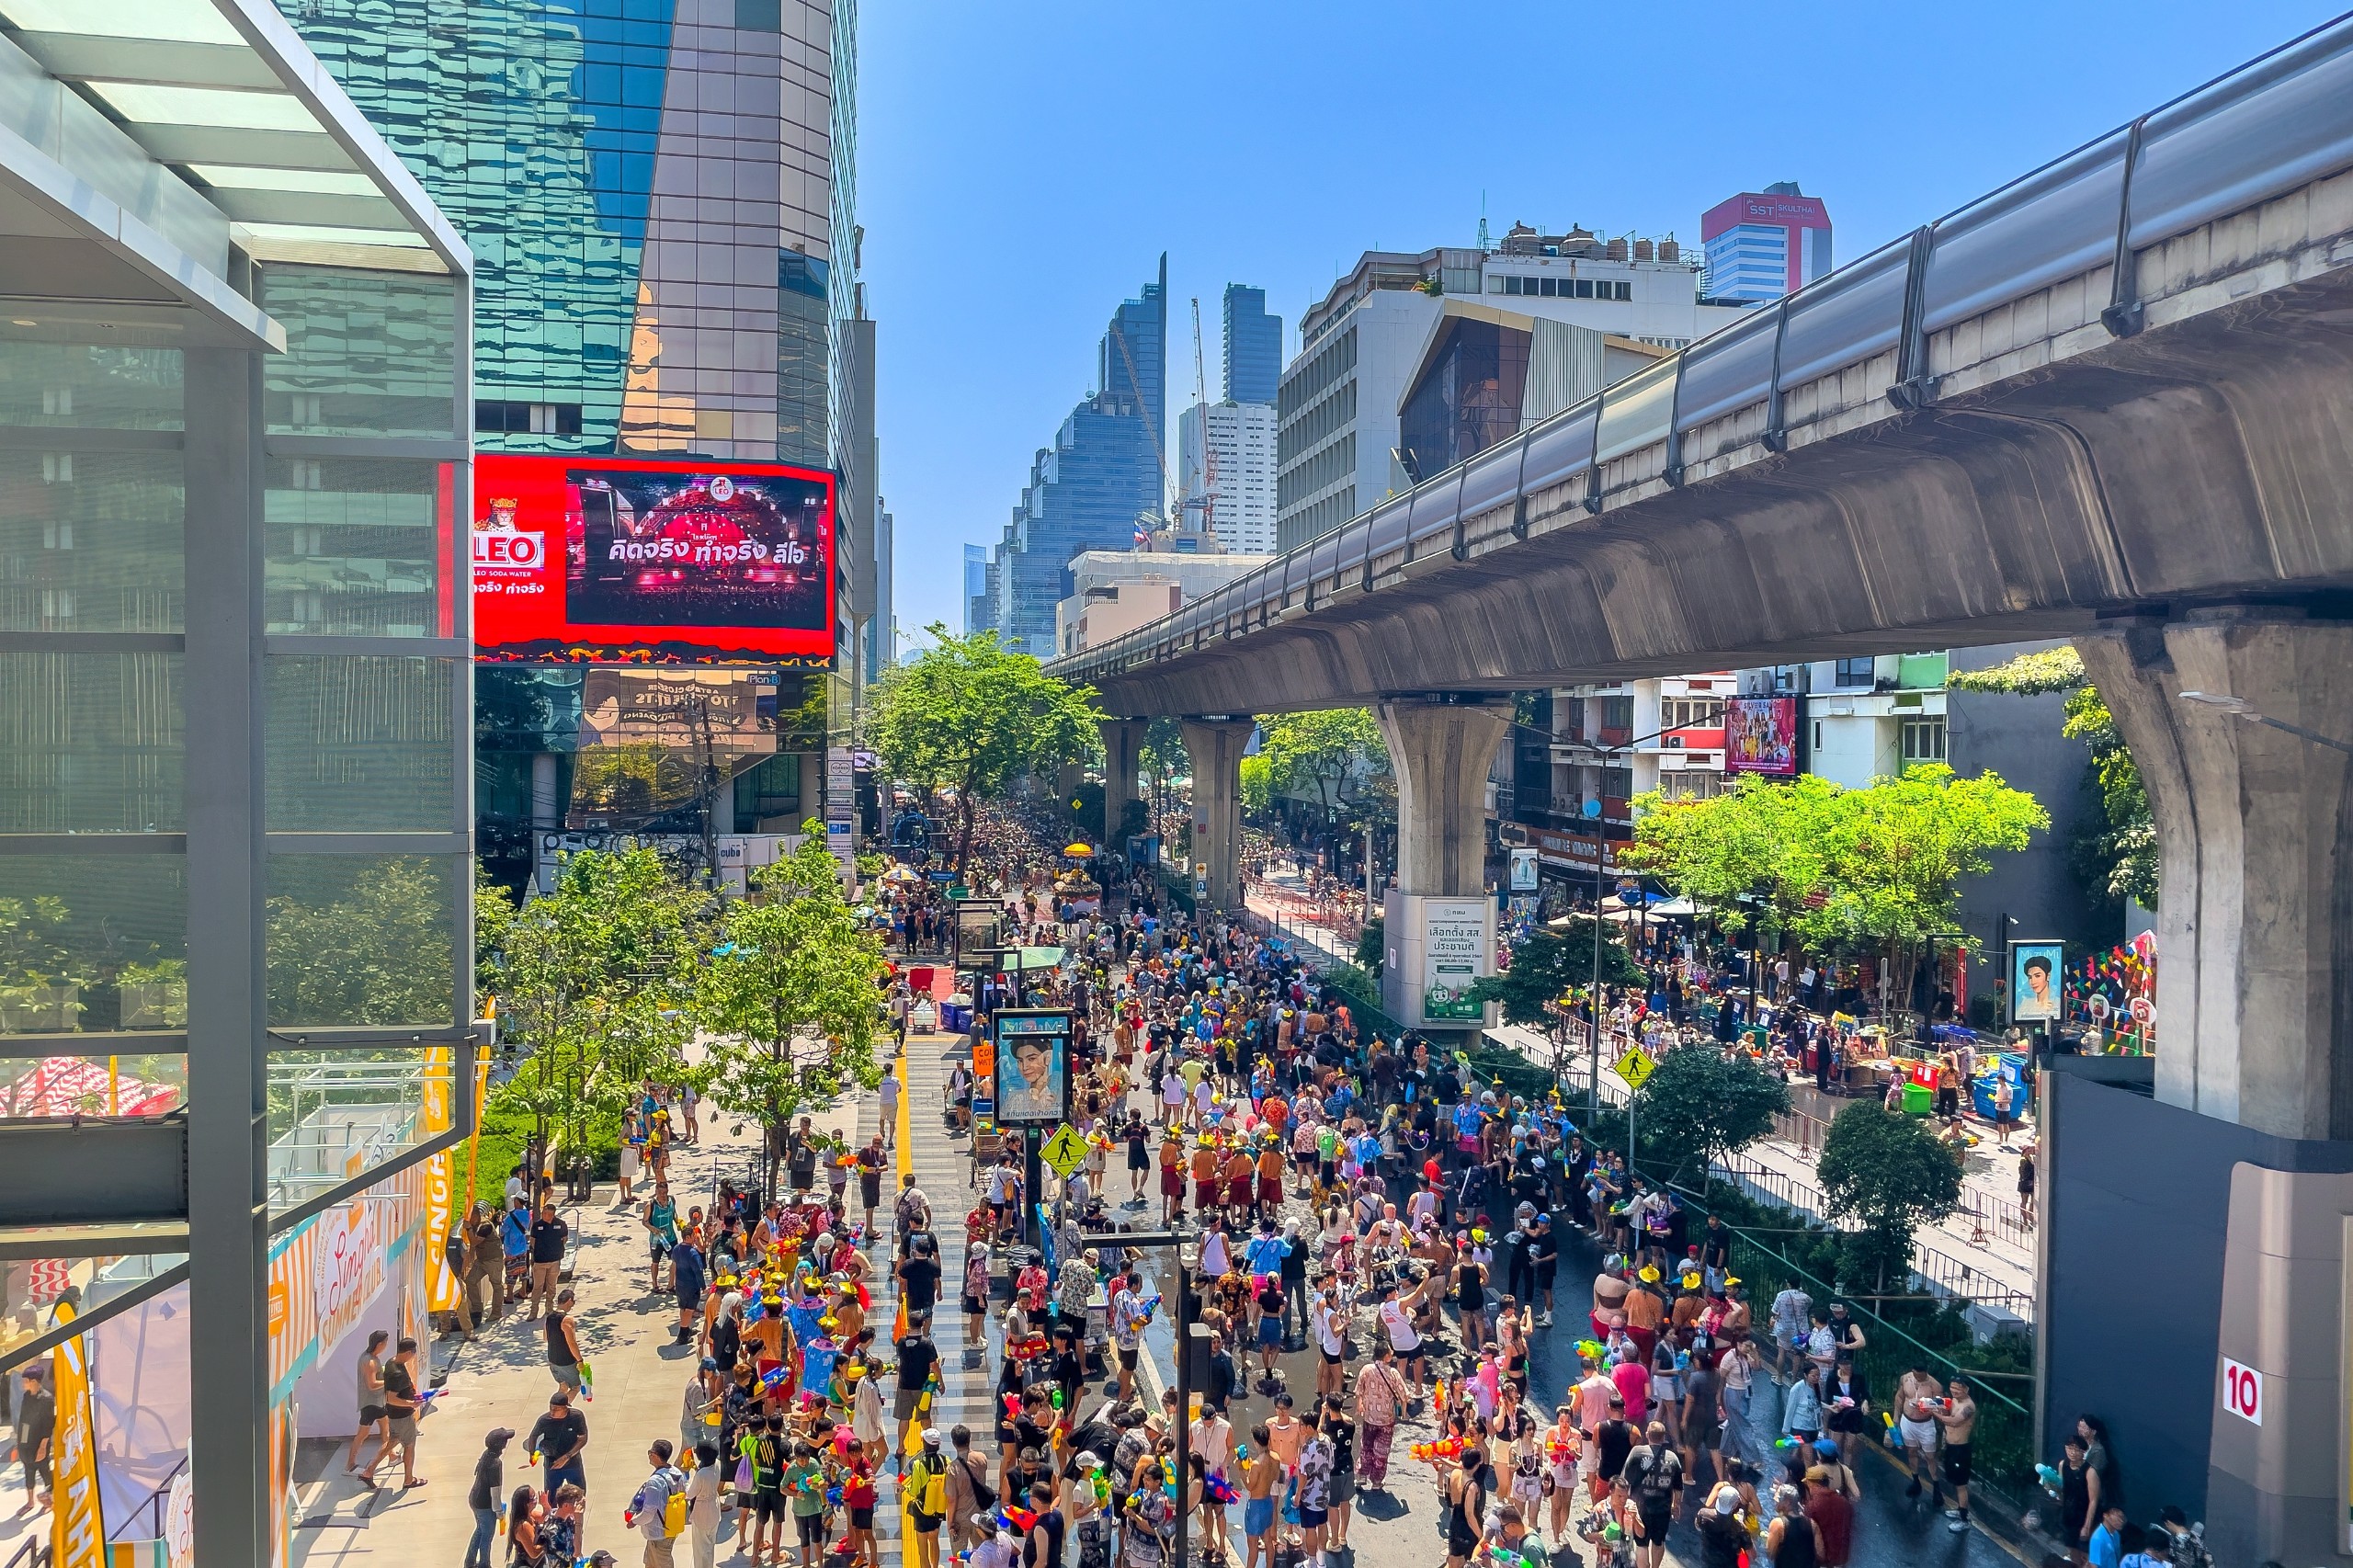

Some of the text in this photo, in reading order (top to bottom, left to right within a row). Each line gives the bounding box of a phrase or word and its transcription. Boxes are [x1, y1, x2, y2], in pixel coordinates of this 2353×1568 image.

[1750, 204, 1775, 216] SST
[1778, 203, 1815, 214] SKULTHAI
[473, 536, 538, 565] LEO
[608, 538, 804, 564] คิดจริง ทำจริง ลีโอ
[506, 582, 545, 595] ทำจริง
[1429, 925, 1482, 937] เลือกตั้ง สส.
[1434, 941, 1474, 951] ประชามติ
[978, 1049, 993, 1057] COL
[429, 1147, 449, 1267] SINGH
[2228, 1365, 2258, 1417] 10
